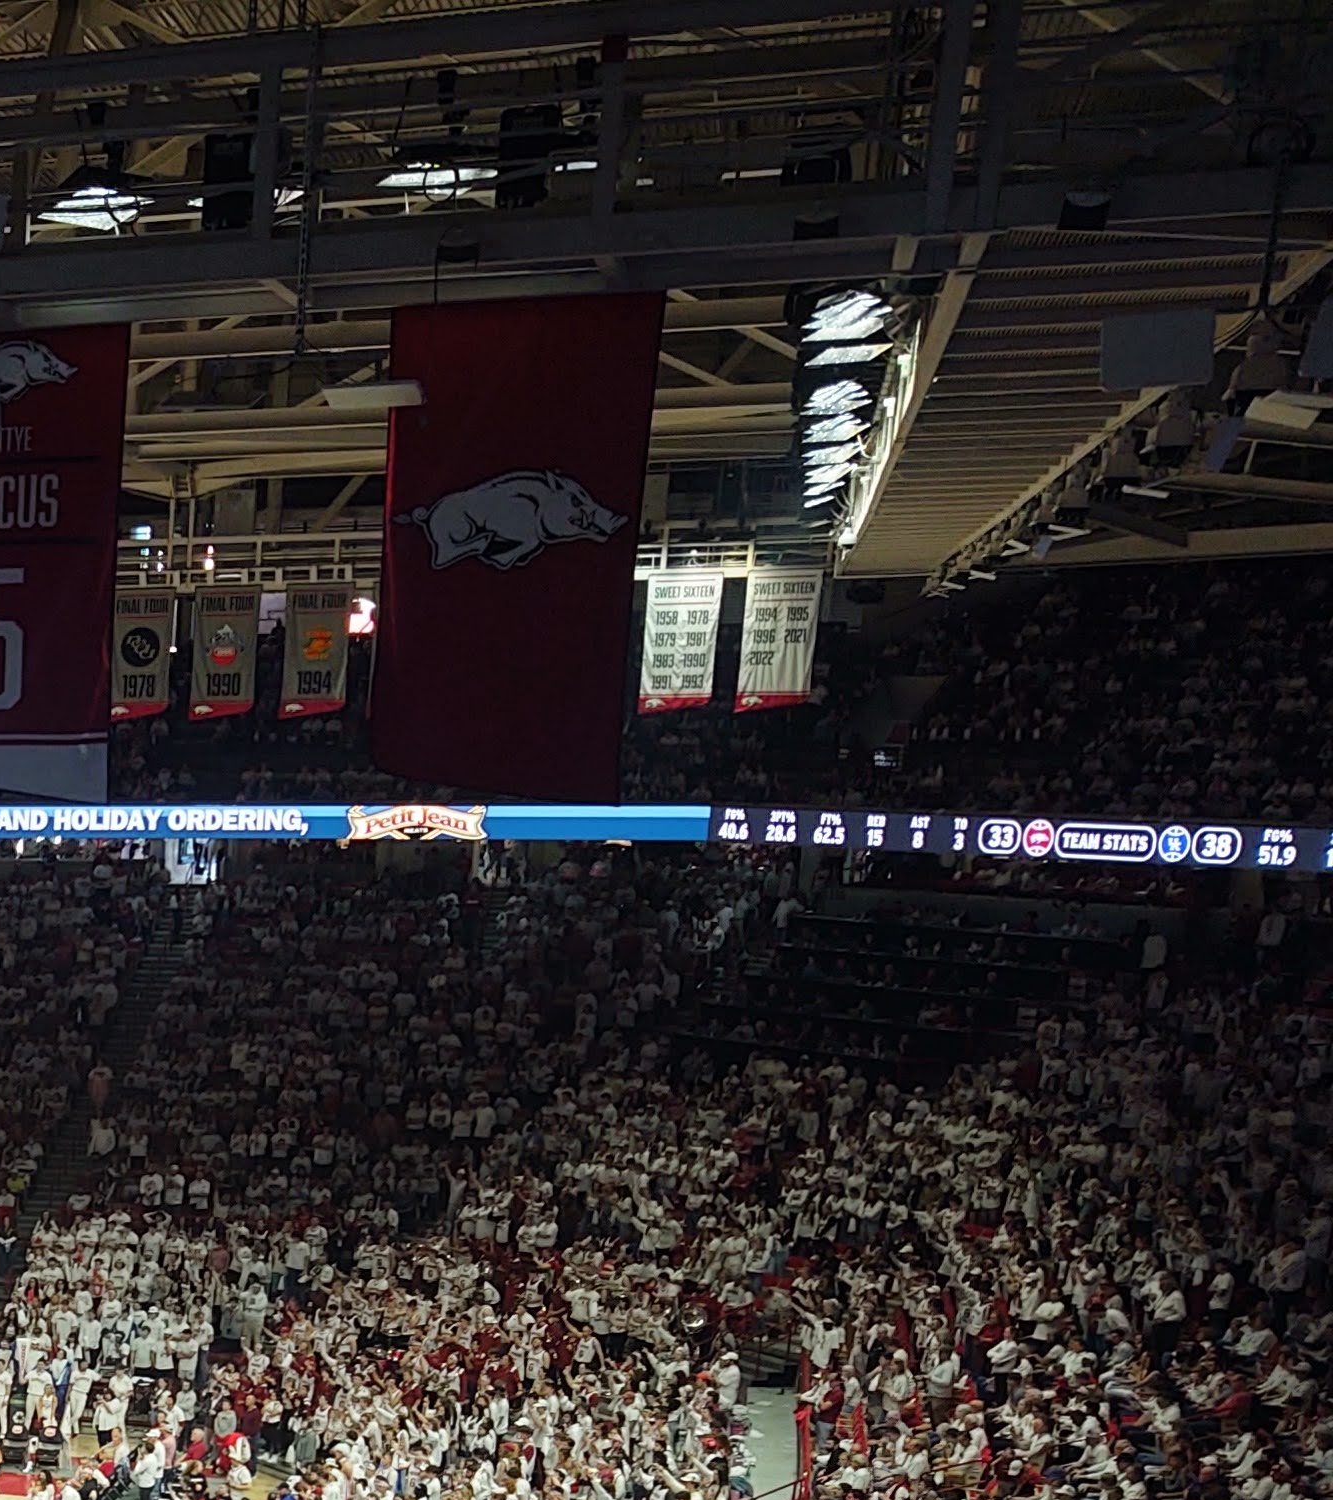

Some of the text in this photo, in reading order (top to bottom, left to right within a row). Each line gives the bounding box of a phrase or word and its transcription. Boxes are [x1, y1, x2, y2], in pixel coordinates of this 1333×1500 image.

[654, 585, 715, 599] SWEET SIXTEEN
[754, 581, 816, 595] SWEET SIXTEEN
[656, 609, 710, 625] 1958 1978
[755, 606, 809, 622] 1994 1995
[654, 631, 707, 648] 1979 1981
[752, 628, 807, 644] 1996 2021
[652, 653, 706, 669] 1983 1990
[749, 652, 774, 666] 2022
[123, 674, 156, 698] 1978
[206, 672, 241, 697] 1990
[297, 671, 333, 695] 1994
[651, 674, 704, 690] 1991 1993
[53, 808, 164, 832] HOLIDAY
[167, 808, 309, 836] ORDERING,
[365, 806, 469, 834] Petit Jean
[820, 813, 842, 826] FT%
[910, 816, 931, 829] AST
[954, 818, 969, 831] TO
[718, 822, 965, 851] 40.6 28.6 62.5 15 8 3
[988, 825, 1015, 849] 33
[1062, 831, 1149, 853] TEAM STATS
[1263, 828, 1294, 844] FG%
[1201, 833, 1233, 858] 38
[1257, 844, 1298, 867] 51.9
